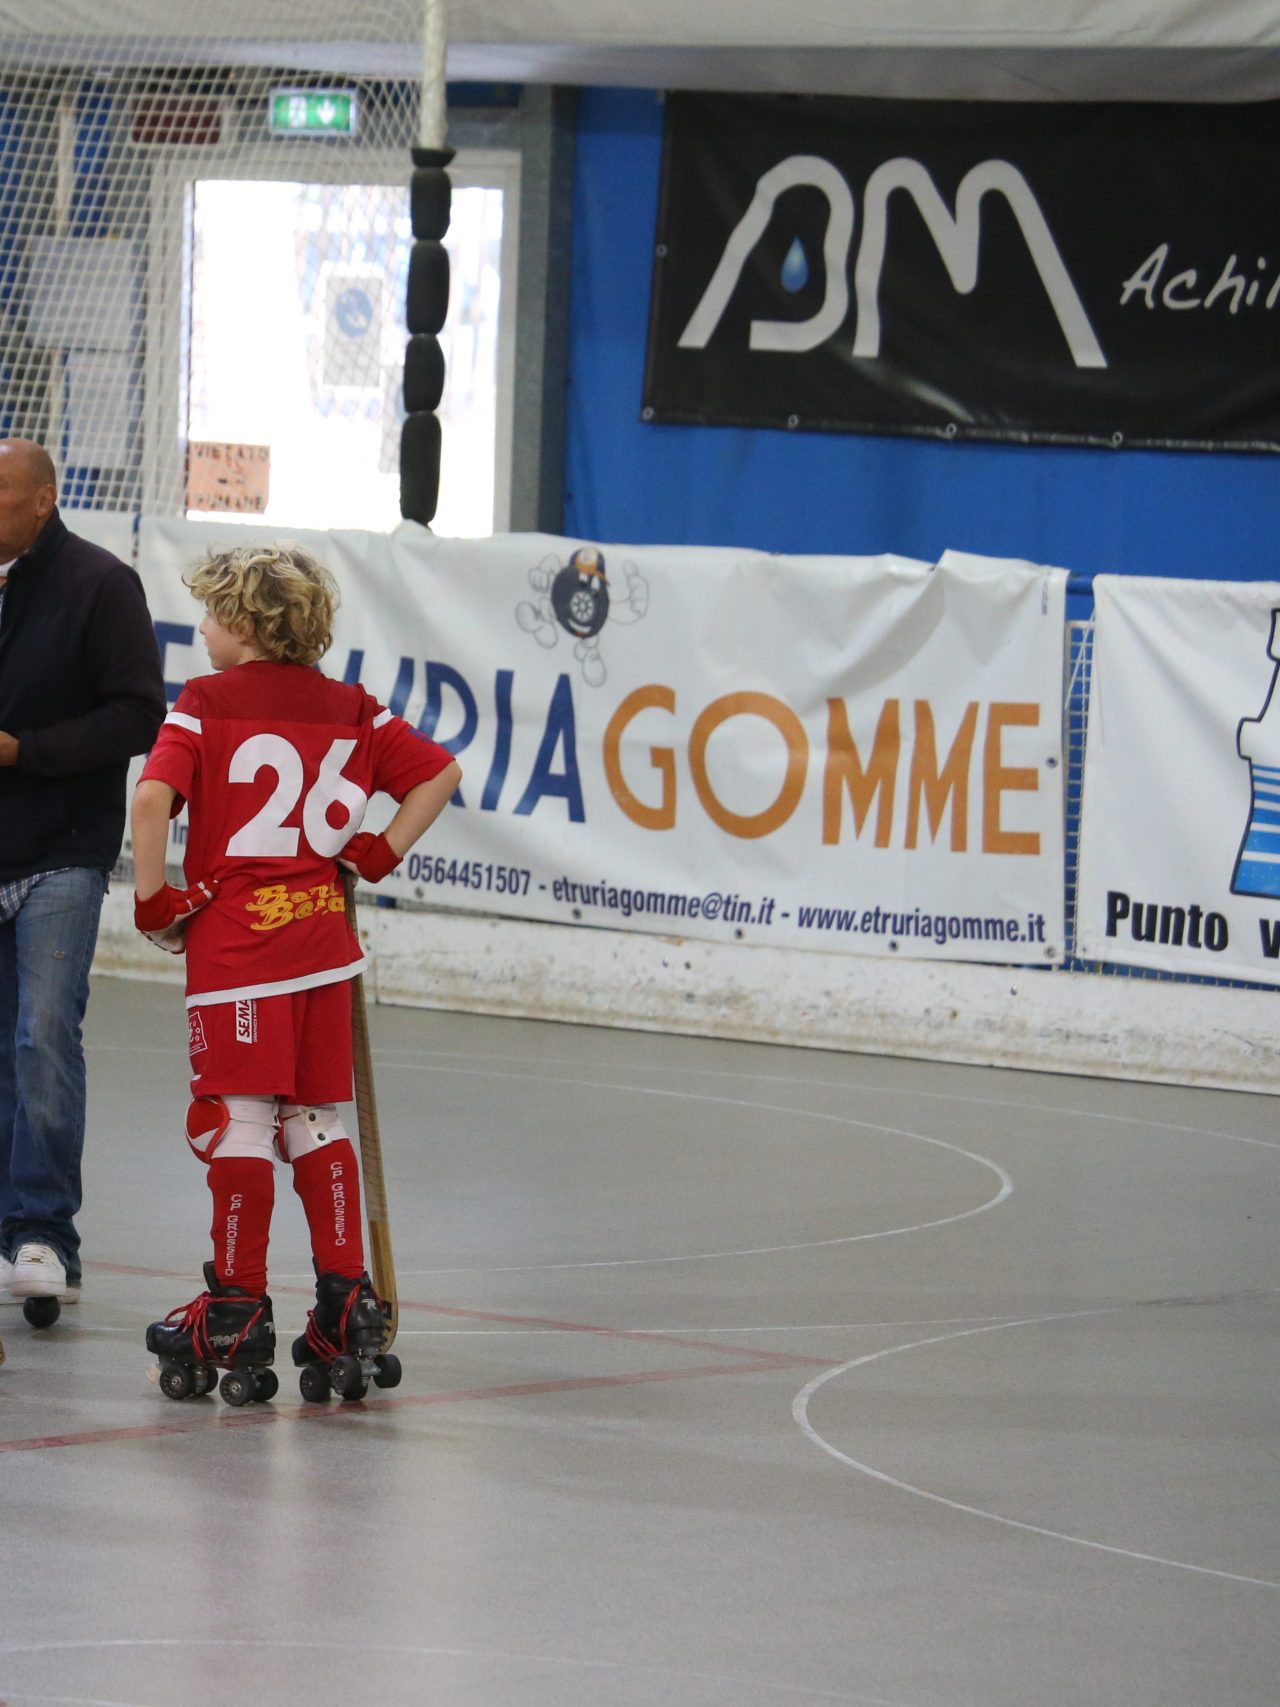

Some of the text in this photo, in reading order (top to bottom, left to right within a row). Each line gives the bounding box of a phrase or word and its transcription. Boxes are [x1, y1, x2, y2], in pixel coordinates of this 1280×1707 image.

[225, 733, 367, 857] 26
[408, 853, 531, 896] 0564451507
[552, 875, 776, 926] etruriagomme@tin.it
[797, 905, 1046, 945] www.etruriagomme.it
[1105, 890, 1229, 952] Punto
[224, 1194, 243, 1277] CP GROSSETO
[330, 1161, 347, 1246] CP GROSSETO
